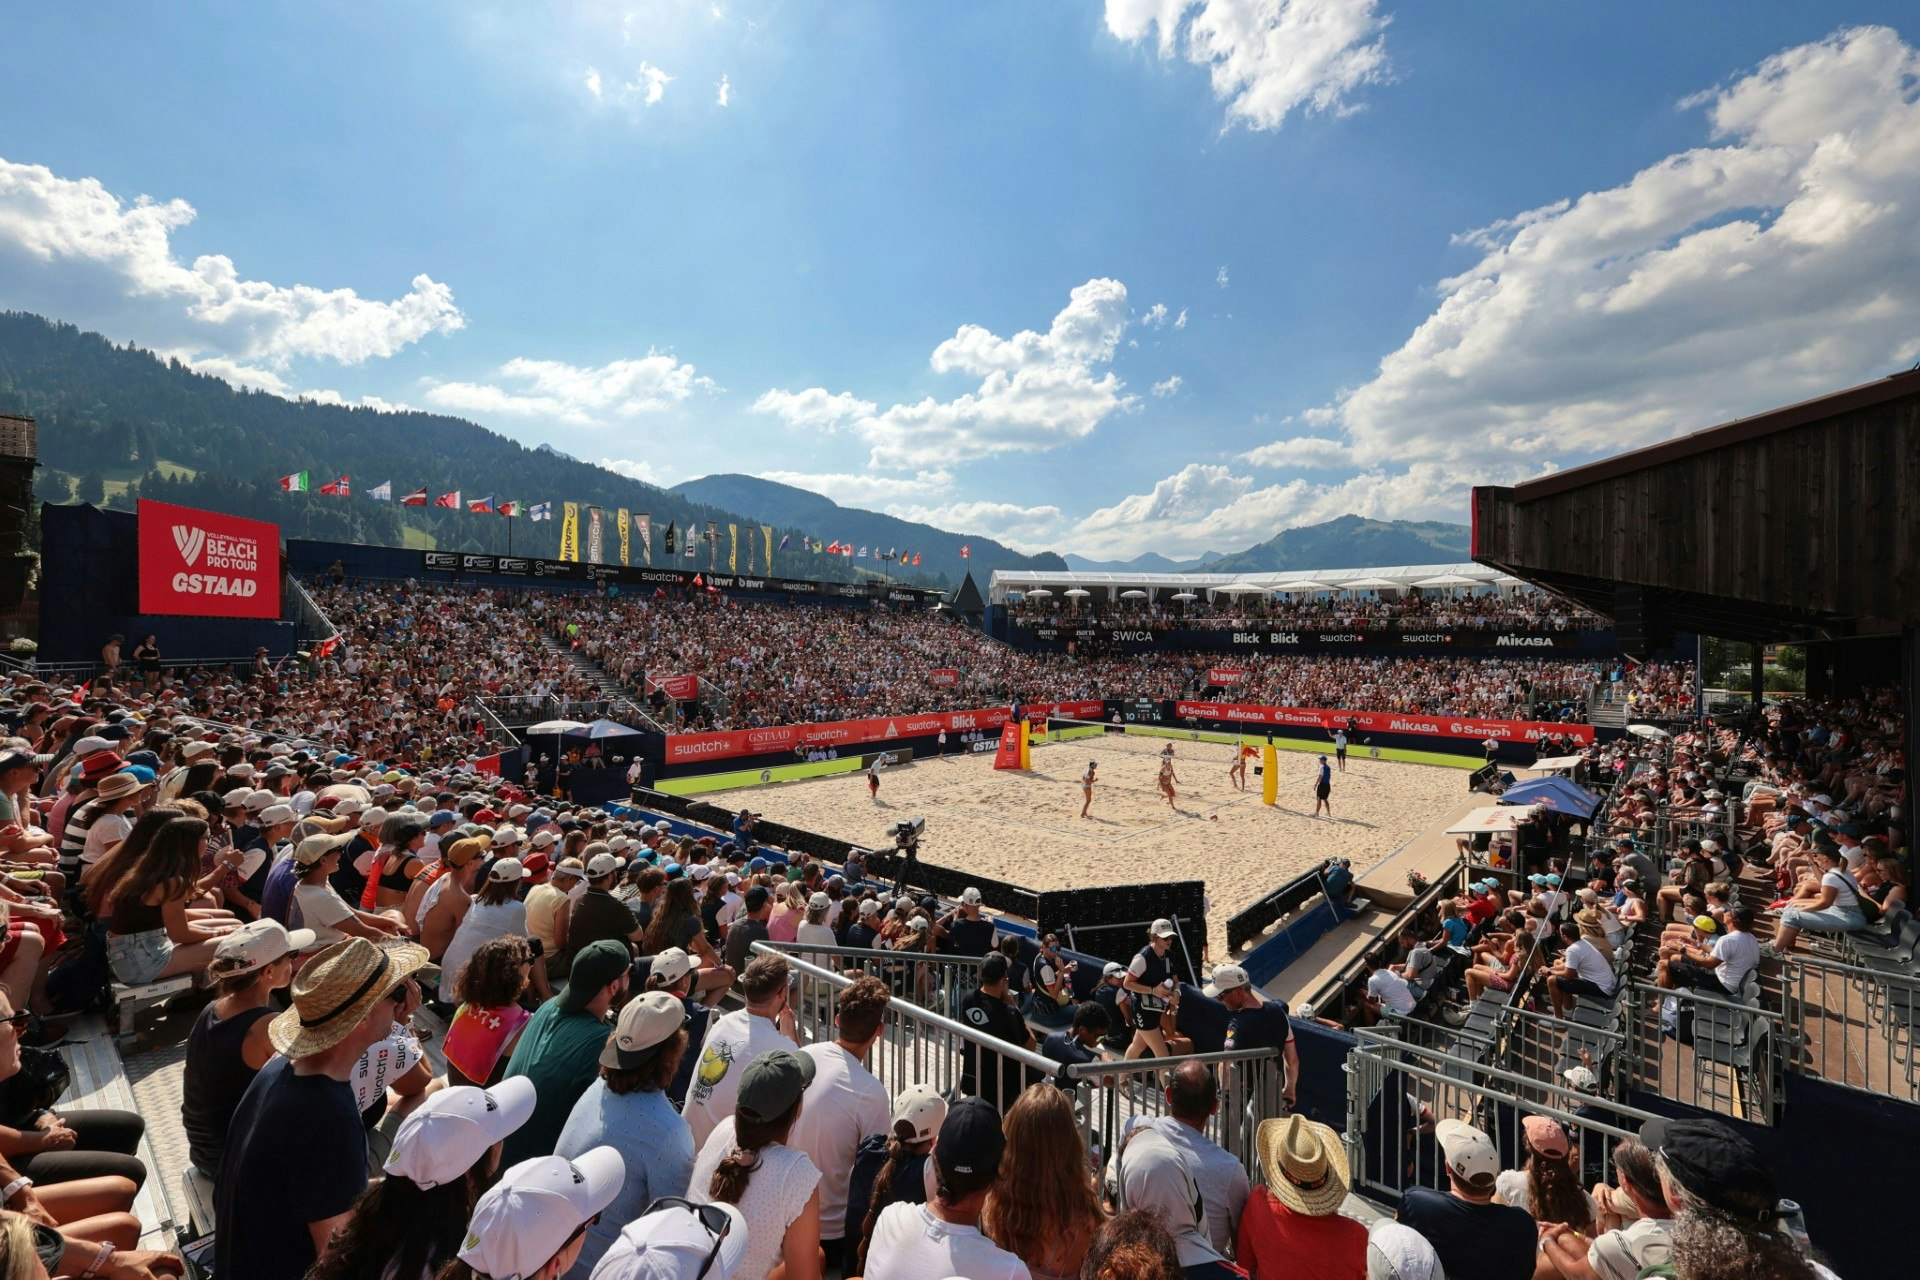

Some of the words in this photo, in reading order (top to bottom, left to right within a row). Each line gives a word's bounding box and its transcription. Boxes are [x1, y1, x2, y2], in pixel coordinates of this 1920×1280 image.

[207, 532, 238, 542] VOLLEYBALL
[239, 537, 257, 545] WORLD
[206, 539, 257, 560] BEACH
[207, 556, 230, 569] PRO
[230, 560, 257, 572] TOUR
[642, 572, 678, 582] swatch
[714, 577, 734, 587] BWT
[172, 572, 257, 597] GSTAAD
[746, 580, 764, 589] BWT
[889, 590, 915, 602] MIKASA
[1112, 631, 1153, 642] SW/CA
[1233, 632, 1260, 644] Blick
[1271, 632, 1299, 644] Blick
[1402, 634, 1444, 642] swatch
[1496, 633, 1553, 646] MIKASA
[1126, 713, 1135, 721] 10
[1187, 707, 1219, 716] Senoh
[1227, 709, 1265, 720] MIKASA
[952, 714, 976, 728] Blick
[1285, 714, 1321, 723] Senoh
[1334, 716, 1373, 724] GSAAD
[906, 720, 936, 731] swatch
[1389, 719, 1438, 733] MIKASA
[1464, 725, 1510, 737] Senoh
[749, 730, 790, 742] GSTAAD
[807, 729, 842, 742] swatch
[1525, 727, 1584, 742] MIKASA
[675, 740, 722, 755] swatch
[973, 740, 1000, 752] GSTAA
